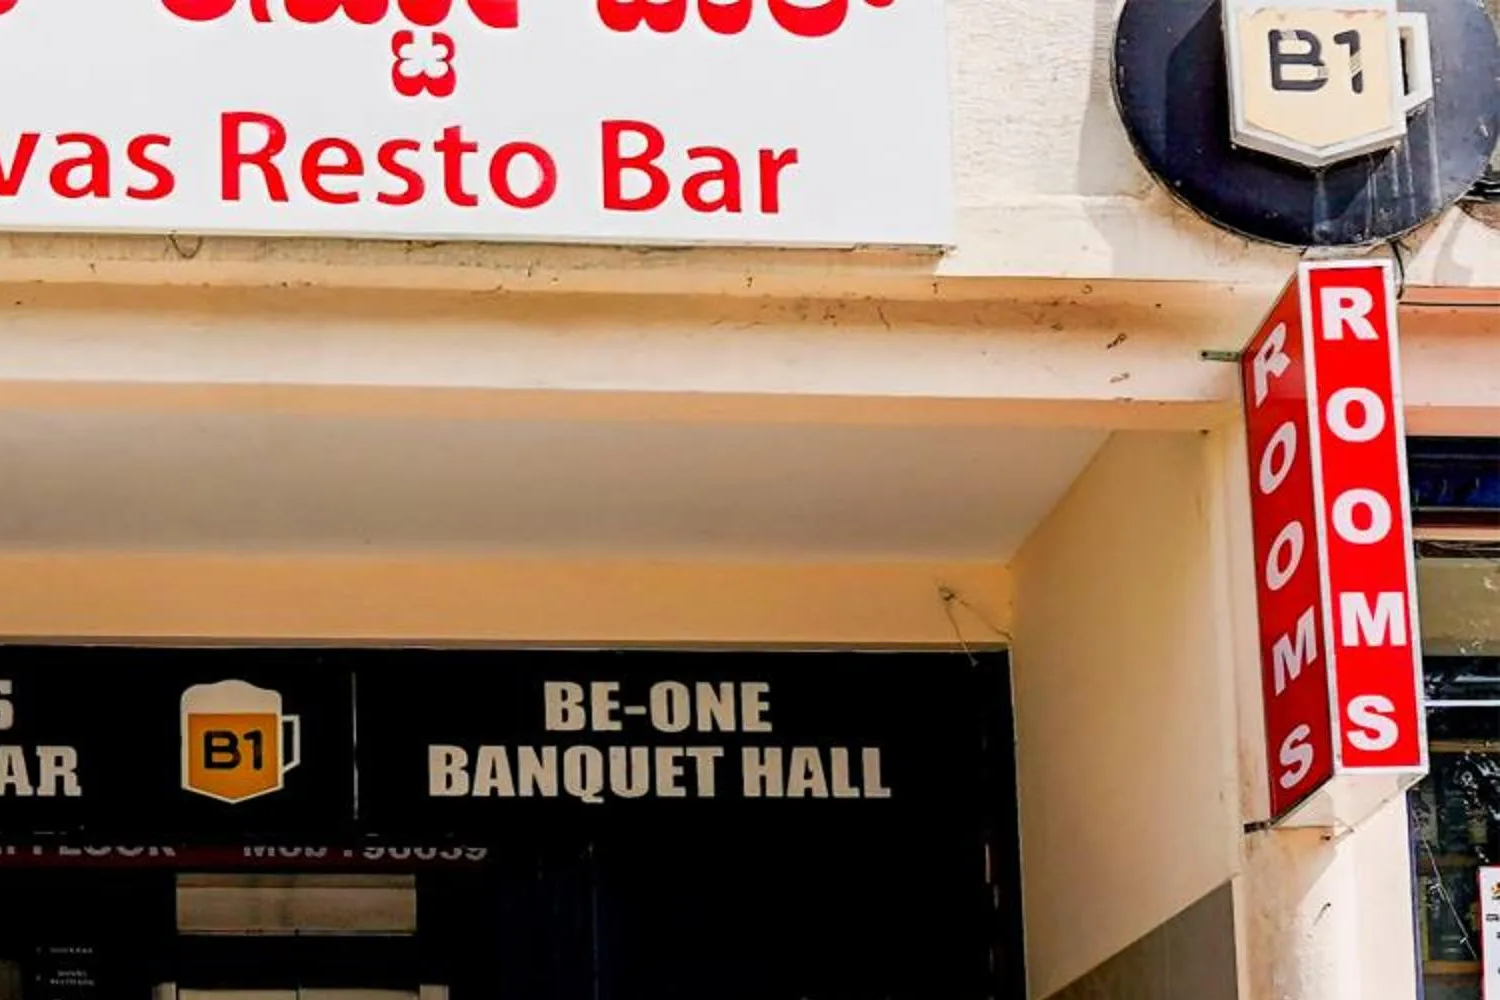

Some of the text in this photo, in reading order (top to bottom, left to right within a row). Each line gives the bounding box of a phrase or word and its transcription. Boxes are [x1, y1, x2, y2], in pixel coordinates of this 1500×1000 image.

[1267, 28, 1364, 94] B1
[220, 110, 558, 210] Resto
[600, 119, 799, 215] Bar
[1319, 286, 1408, 751] ROOMS
[1253, 321, 1318, 789] ROOMS
[543, 681, 774, 733] BE-ONE
[203, 729, 263, 772] B1
[427, 744, 892, 804] BANQUET HALL
